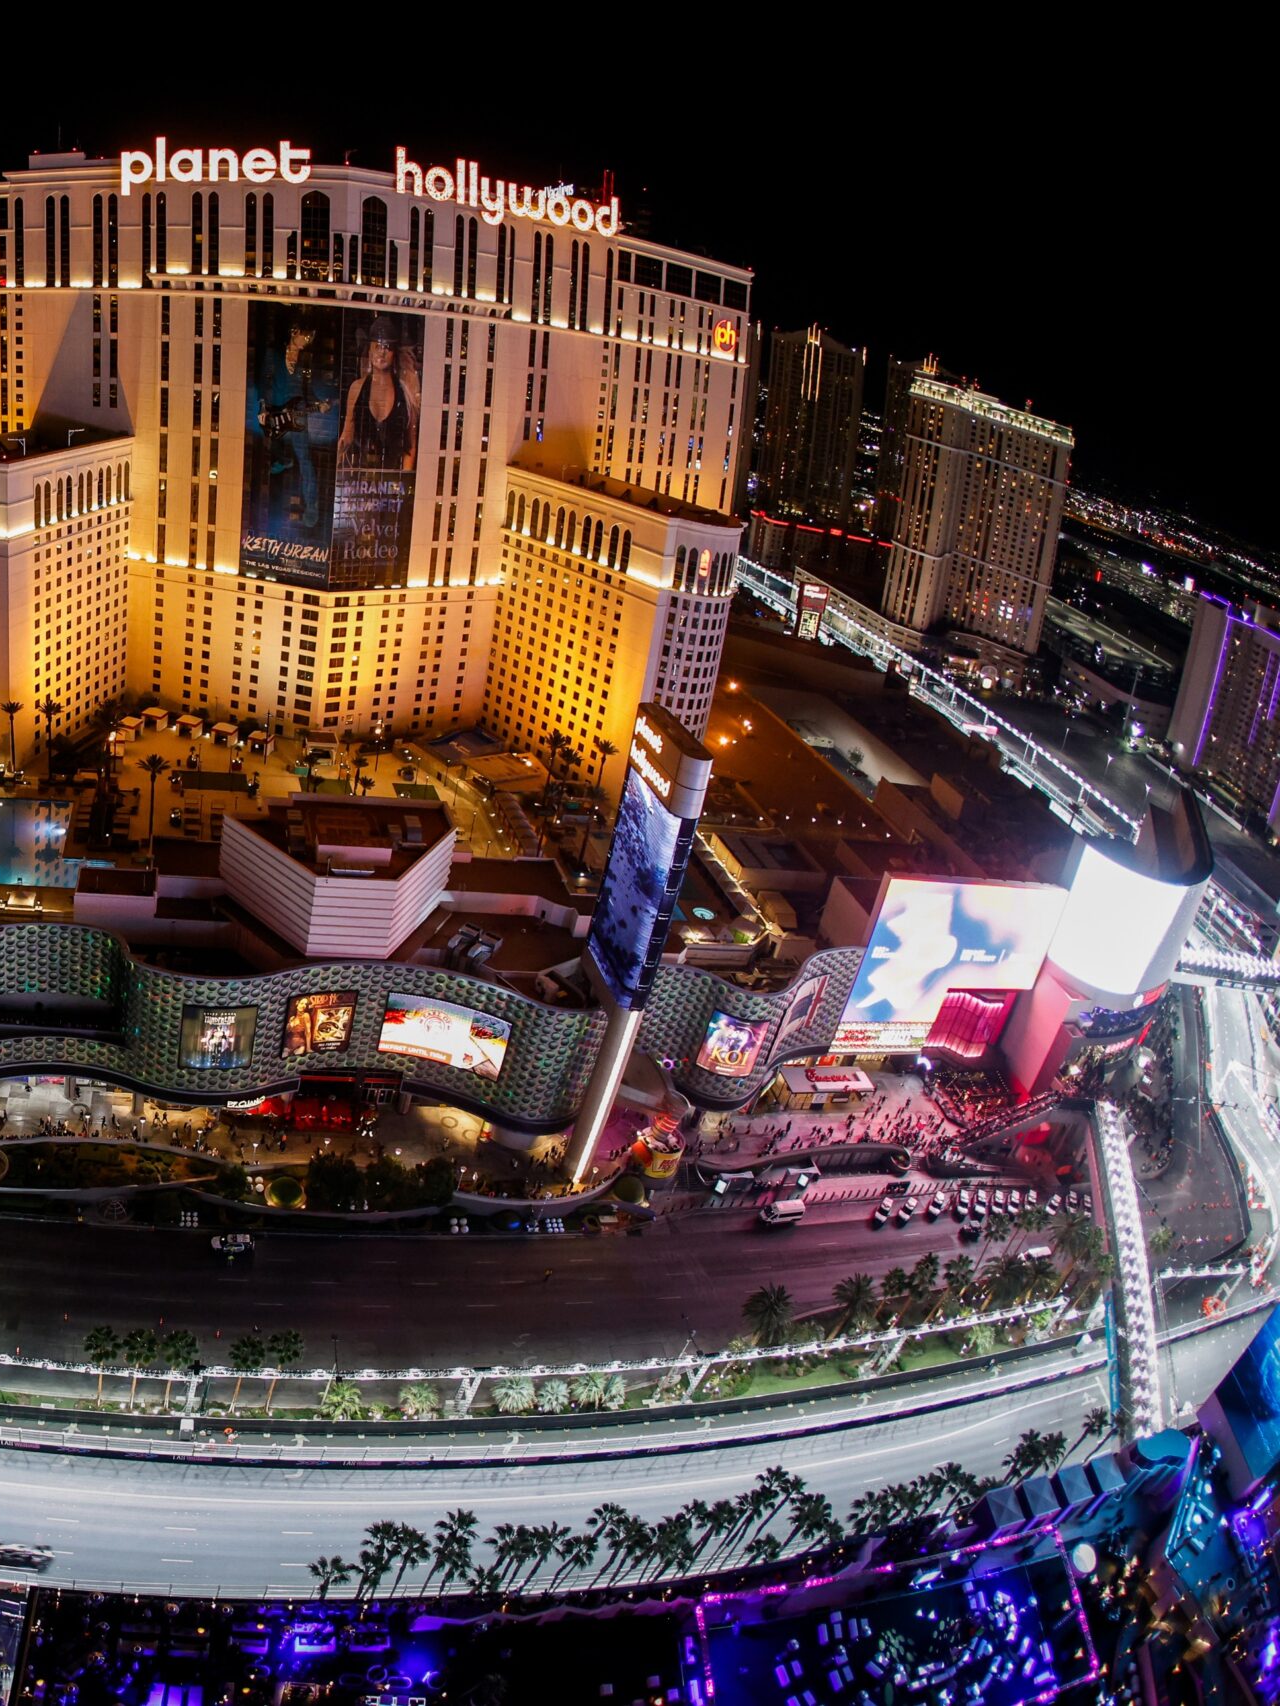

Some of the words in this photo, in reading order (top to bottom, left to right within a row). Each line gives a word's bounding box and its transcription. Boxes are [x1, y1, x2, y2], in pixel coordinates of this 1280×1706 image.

[121, 136, 311, 196] planet
[395, 146, 620, 237] hollywood
[716, 321, 736, 348] ph
[343, 480, 405, 496] MIRANDA
[243, 535, 283, 556] KEITH
[283, 543, 329, 562] URBAN
[343, 539, 399, 560] Rodeo
[634, 715, 663, 754] planet
[630, 738, 671, 797] hollywood
[708, 1046, 751, 1066] KOI
